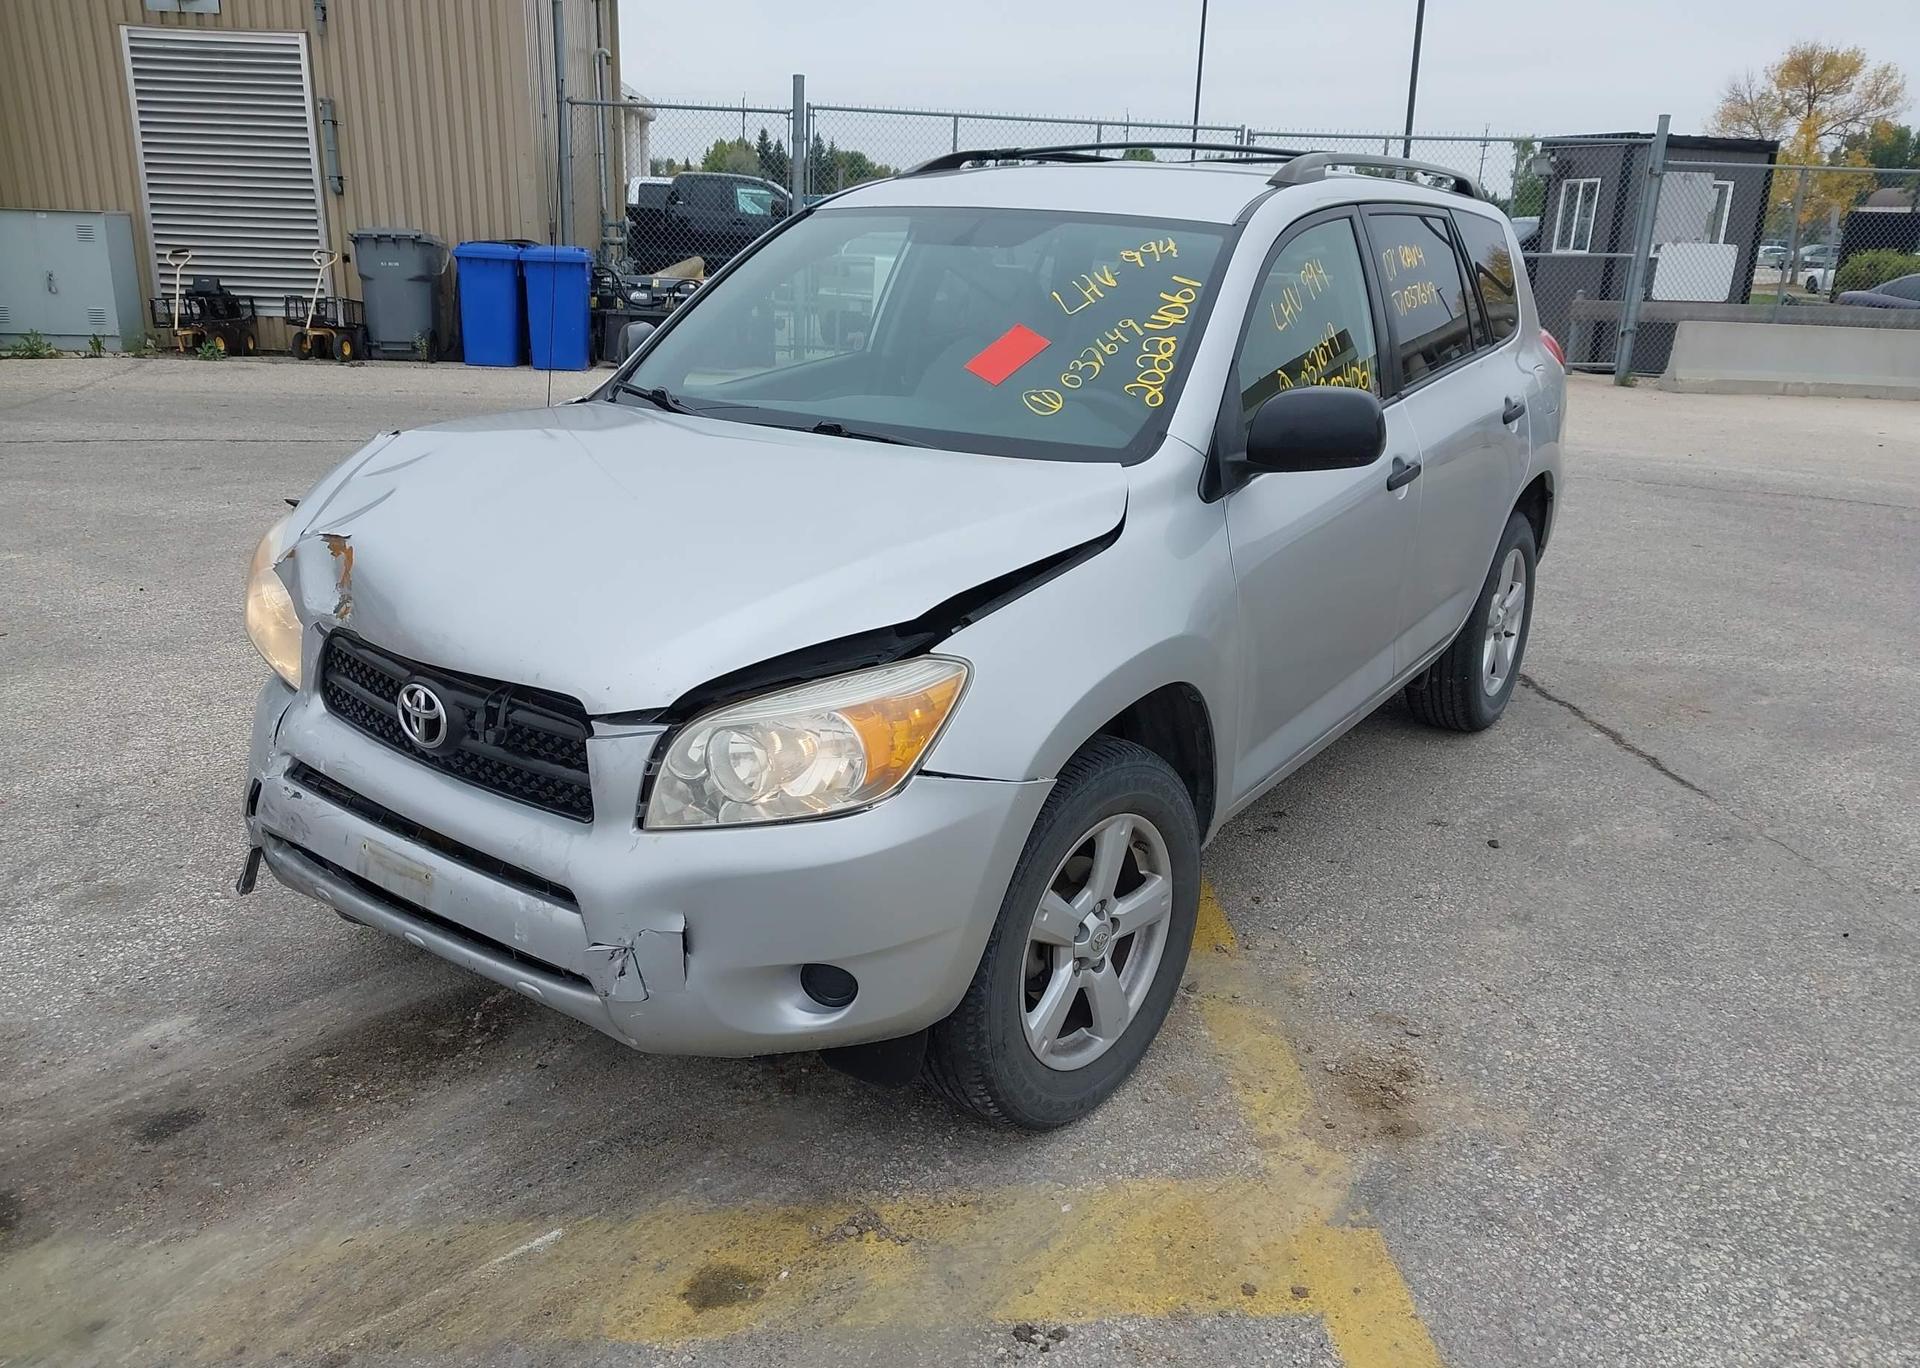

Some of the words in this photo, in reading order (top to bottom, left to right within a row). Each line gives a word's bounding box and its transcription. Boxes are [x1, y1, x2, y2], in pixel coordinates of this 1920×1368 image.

[1270, 281, 1303, 331] LHV
[1300, 258, 1330, 300] 994
[1061, 318, 1145, 389] 037649
